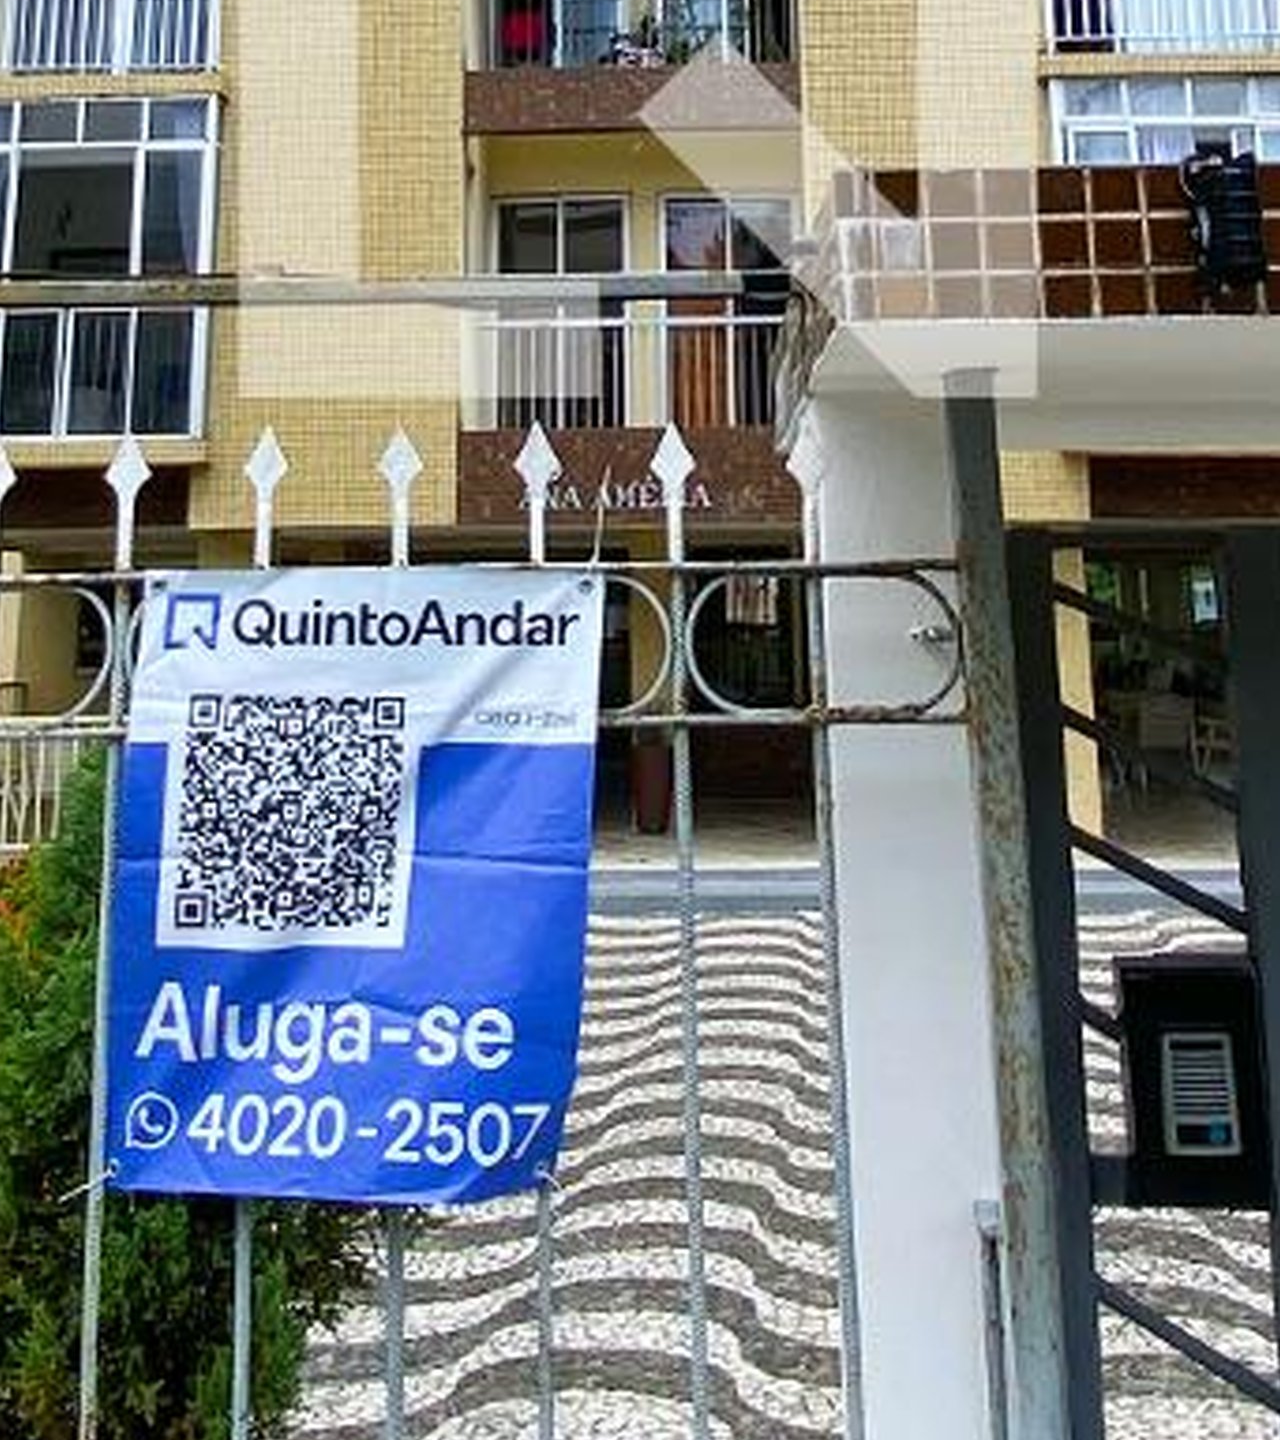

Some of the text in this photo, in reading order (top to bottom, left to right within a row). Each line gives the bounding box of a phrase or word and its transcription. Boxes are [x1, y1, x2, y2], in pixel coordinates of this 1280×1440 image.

[232, 598, 579, 650] QuintoAndar
[135, 980, 515, 1083] Aluga-se
[187, 1093, 551, 1168] 4020-2507
